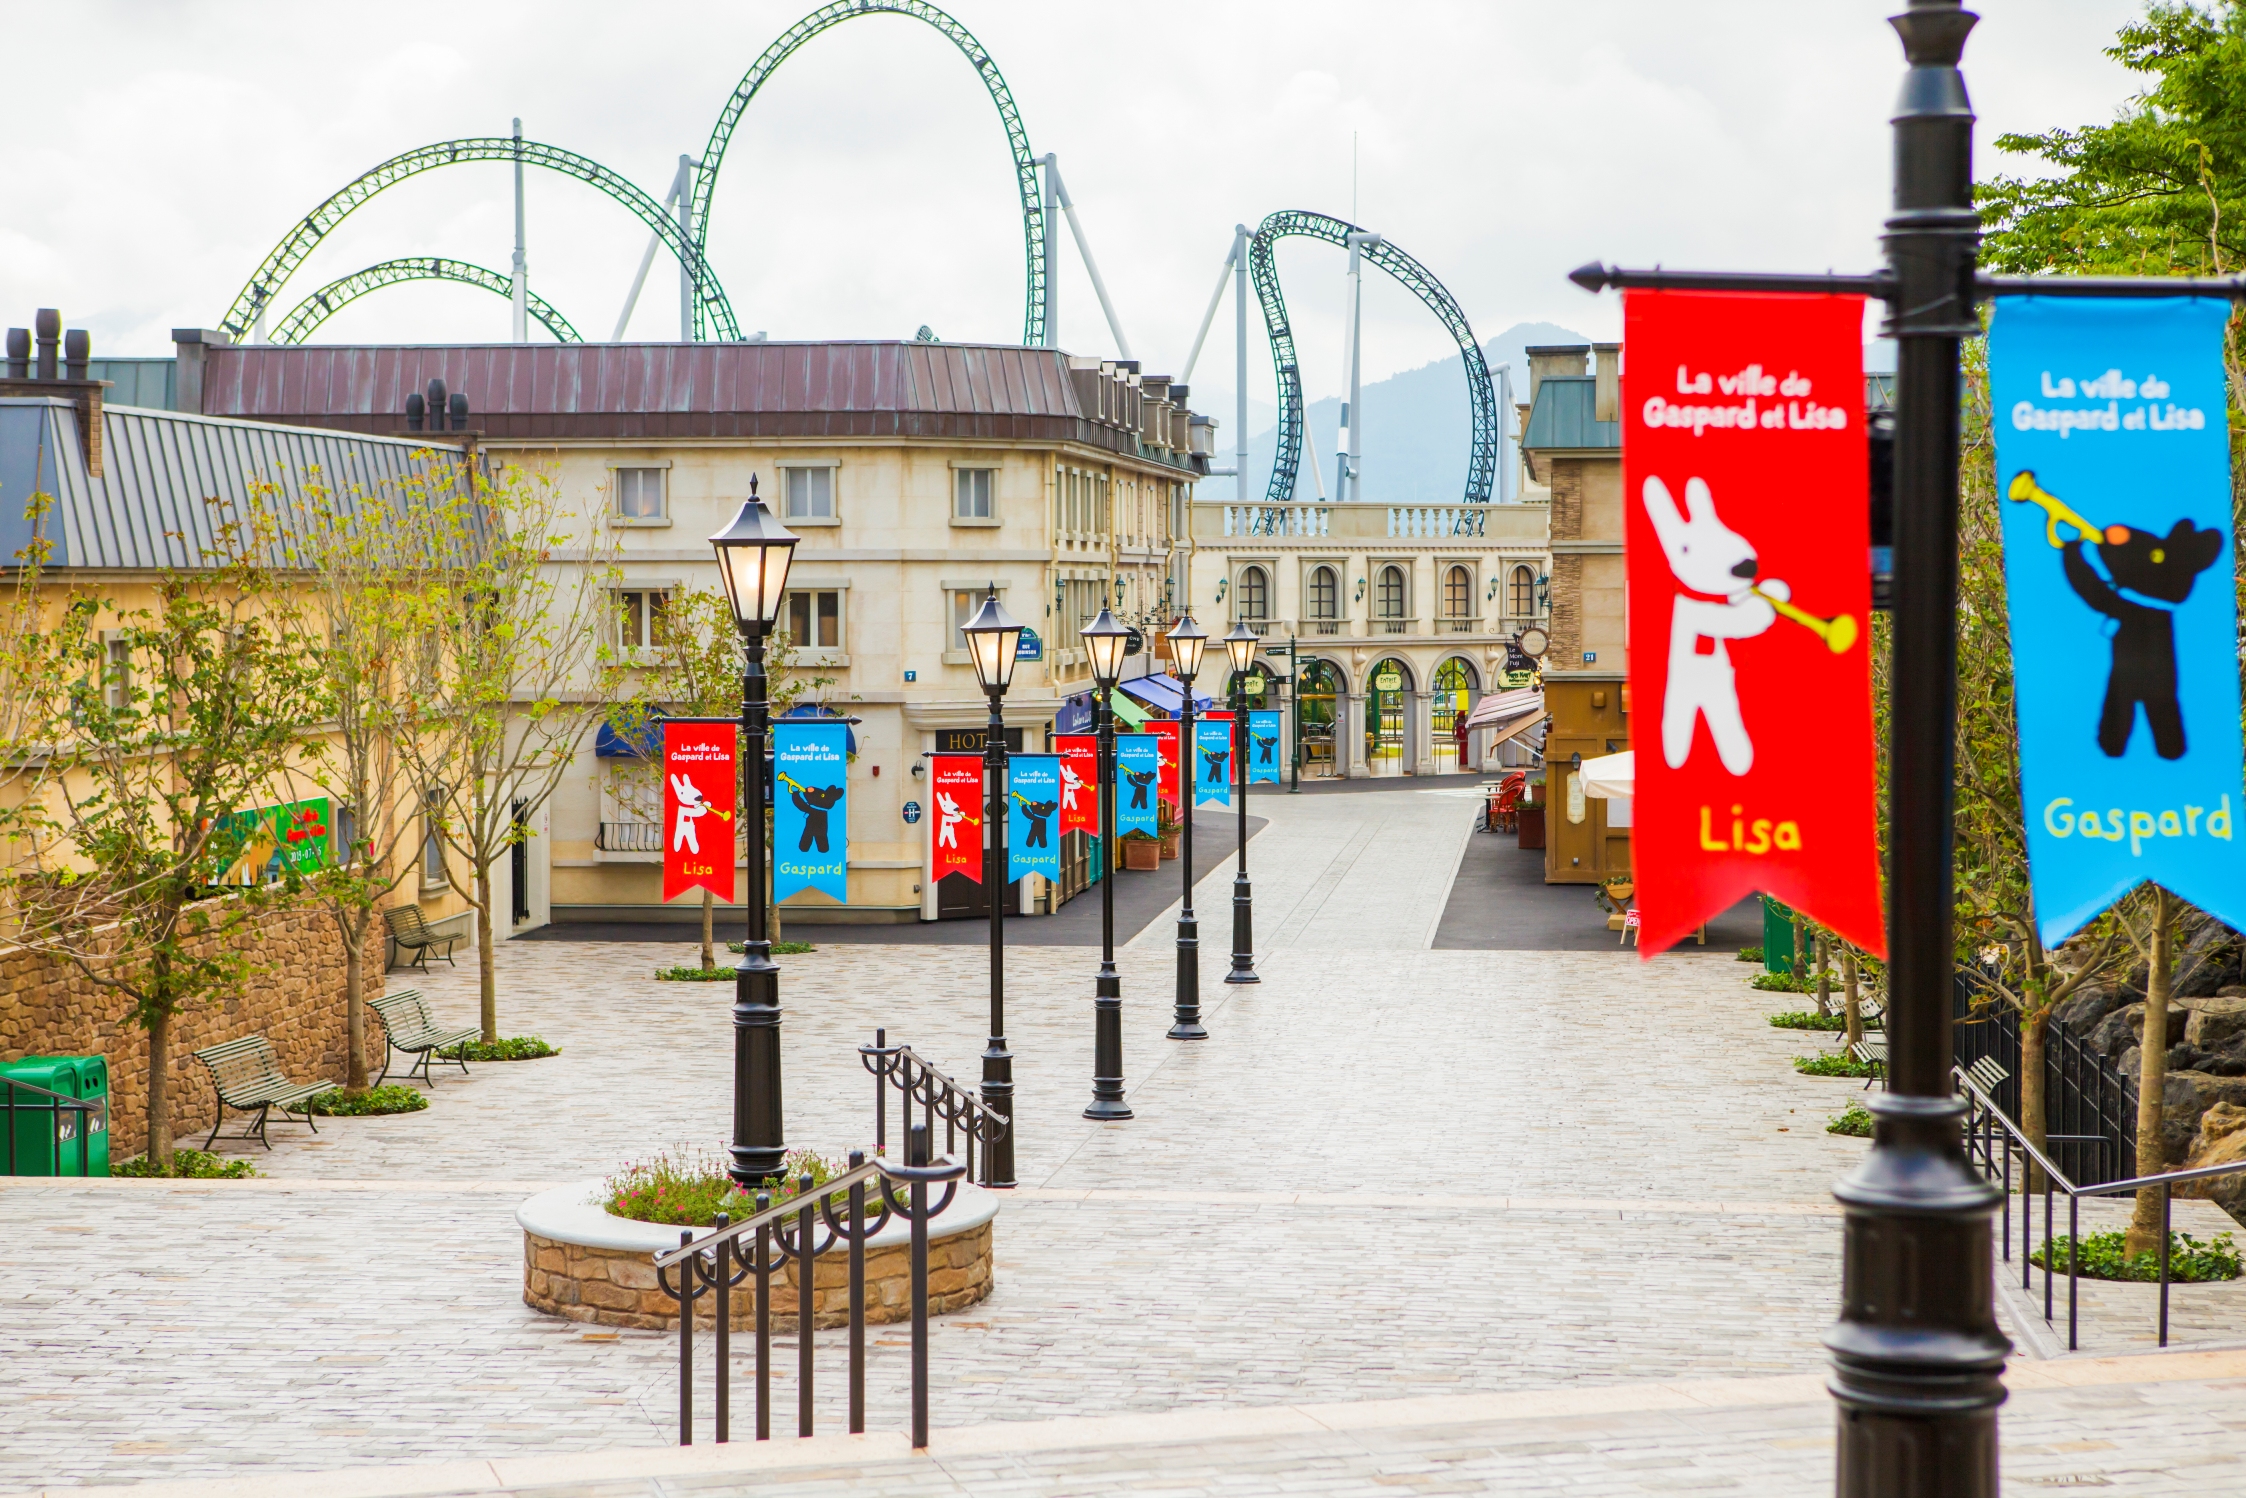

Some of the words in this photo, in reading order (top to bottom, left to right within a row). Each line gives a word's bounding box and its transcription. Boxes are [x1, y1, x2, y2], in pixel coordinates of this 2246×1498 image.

[1677, 366, 1712, 394] La
[1718, 365, 1776, 396] ville
[1780, 371, 1811, 396] de
[2042, 372, 2076, 398] La
[2080, 369, 2136, 399] ville
[2139, 375, 2170, 399] de
[1643, 394, 1758, 436] Gaspard
[1761, 405, 1785, 428] et
[1789, 402, 1846, 429] Lisa
[2012, 398, 2119, 438] Gaspard
[2123, 407, 2146, 430] et
[2150, 404, 2205, 430] Lisa
[1585, 653, 1594, 661] 21
[908, 672, 913, 681] 7
[693, 743, 709, 751] ville
[803, 743, 819, 752] ville
[671, 752, 703, 762] Gaspard
[781, 751, 813, 762] Gaspard
[1014, 776, 1037, 784] Gaspard
[1199, 786, 1228, 796] Gaspard
[1068, 814, 1086, 823] Lisa
[1120, 813, 1155, 824] Gaspard
[1701, 805, 1801, 854] Lisa
[2044, 794, 2232, 856] Gaspard
[946, 854, 966, 864] Lisa
[1013, 855, 1056, 867] Gaspard
[684, 862, 712, 875] Lisa
[780, 862, 841, 879] Gaspard
